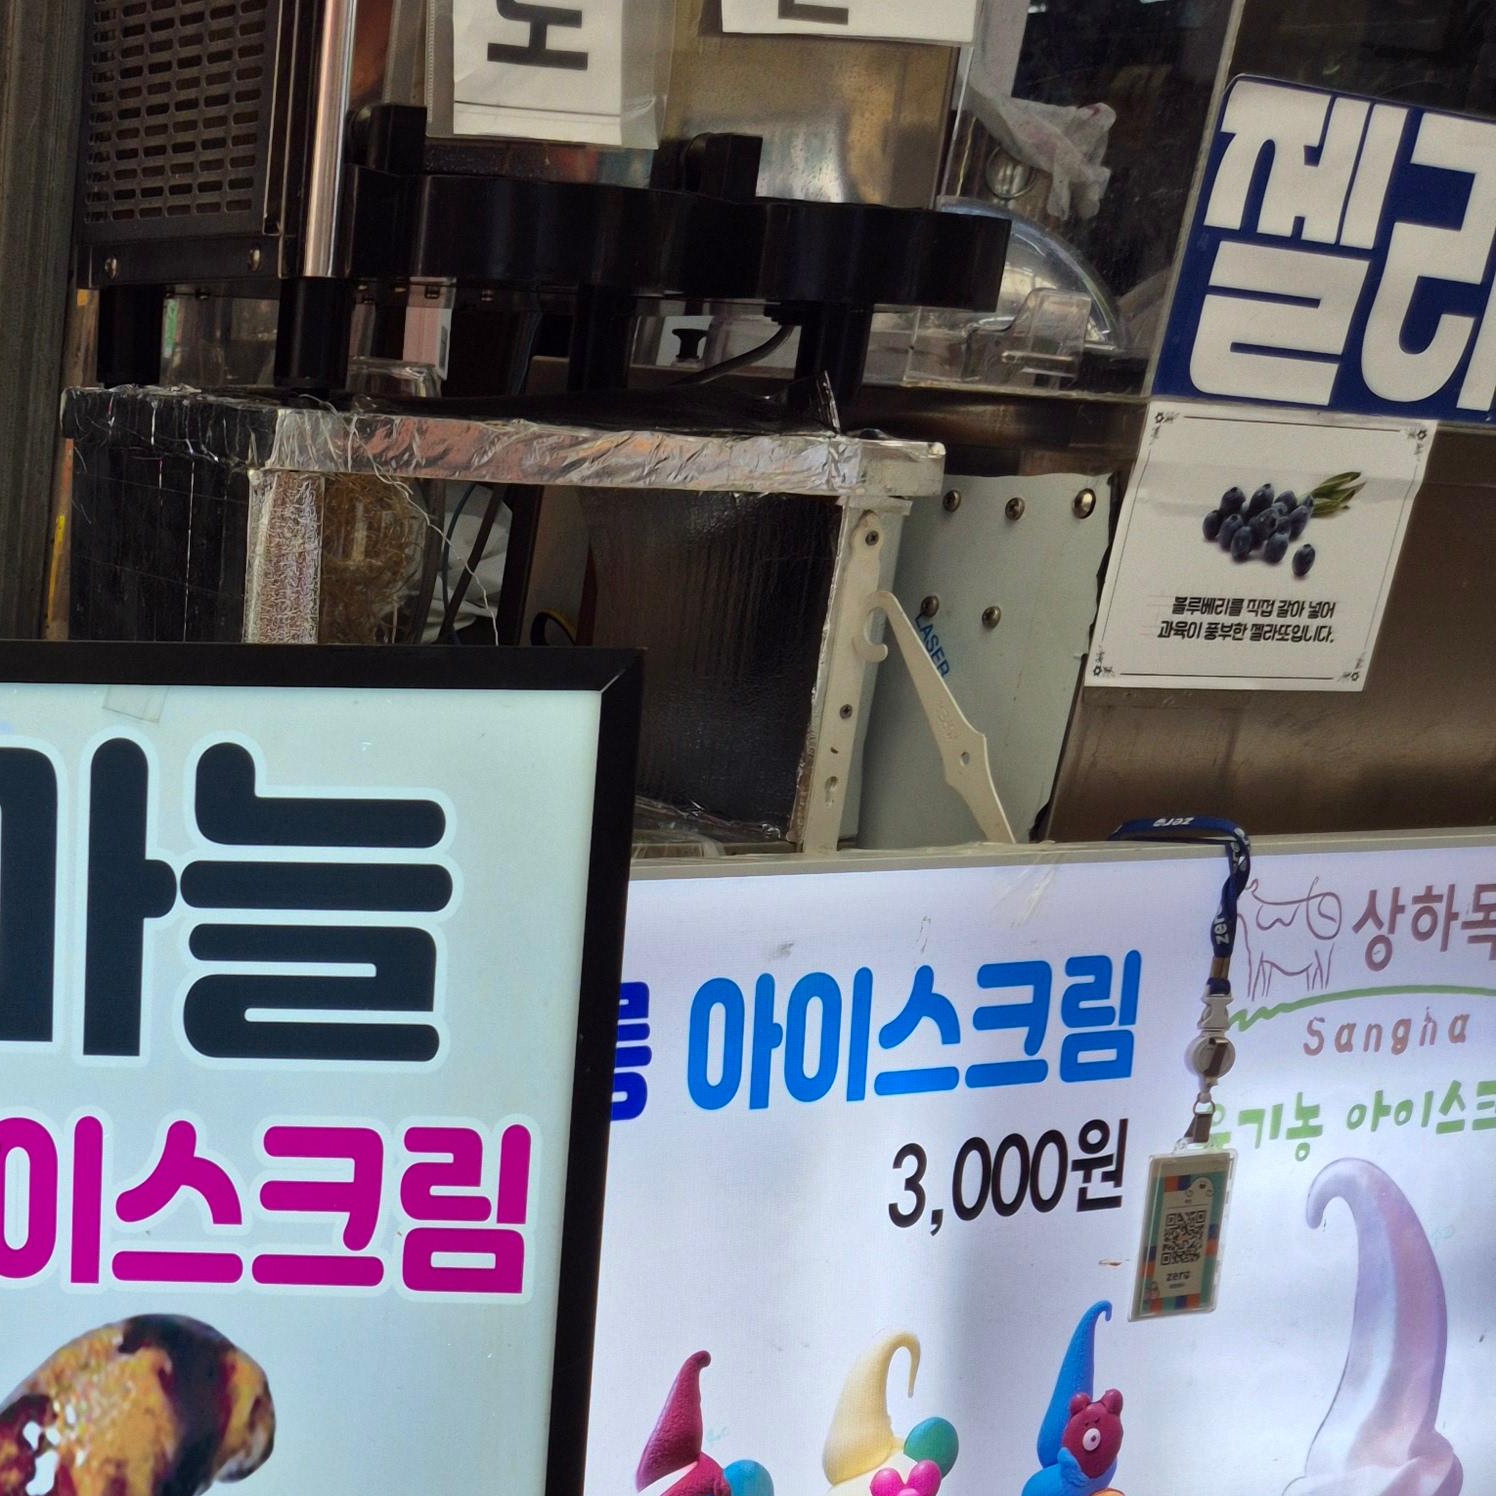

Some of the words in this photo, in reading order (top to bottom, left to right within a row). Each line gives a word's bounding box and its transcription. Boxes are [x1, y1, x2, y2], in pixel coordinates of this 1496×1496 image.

[1157, 620, 1204, 640] 과육이
[1204, 622, 1248, 640] 풍부한
[1249, 623, 1336, 644] 젤라또입니다.
[1172, 596, 1245, 617] 블루베리를
[1247, 599, 1274, 618] 직접
[1276, 600, 1306, 619] 갈아
[1307, 601, 1336, 619] 넣어
[687, 949, 1142, 1110] 아이스크림
[1303, 1005, 1471, 1056] Sangha
[887, 1117, 1130, 1236] 3,000원
